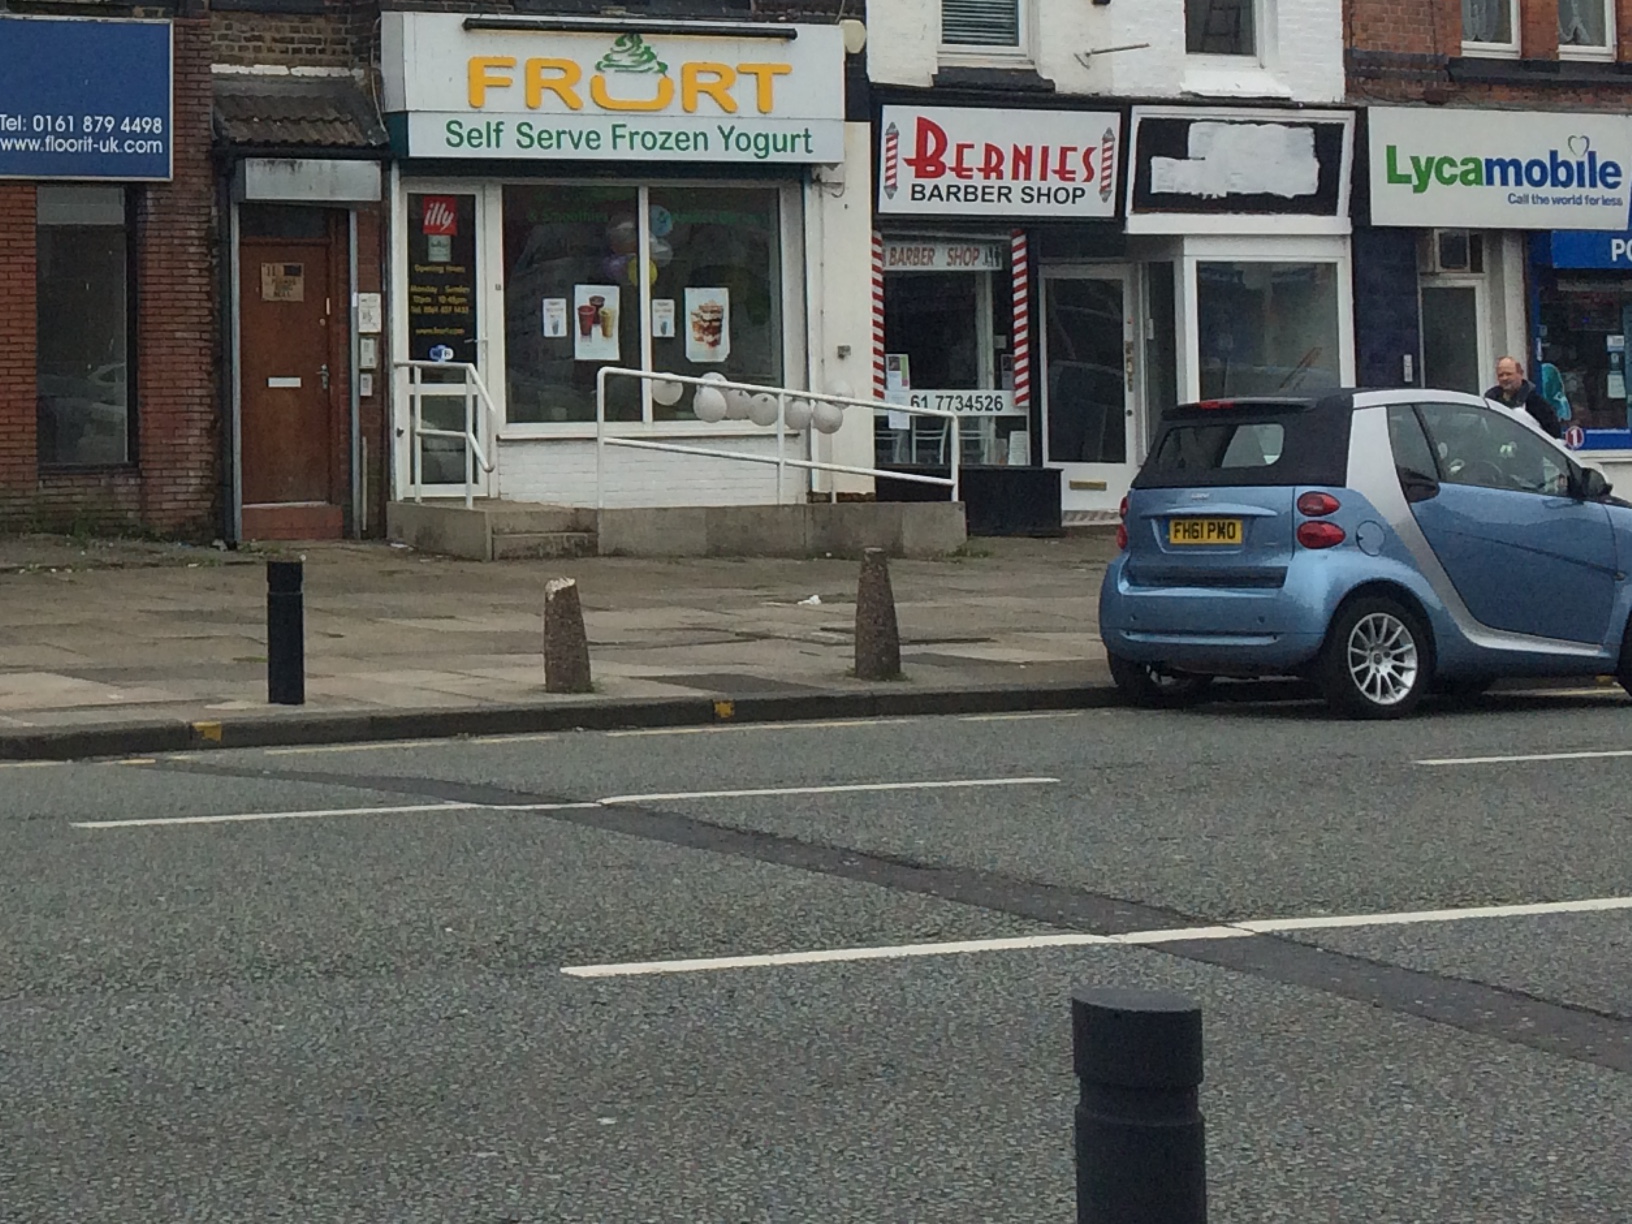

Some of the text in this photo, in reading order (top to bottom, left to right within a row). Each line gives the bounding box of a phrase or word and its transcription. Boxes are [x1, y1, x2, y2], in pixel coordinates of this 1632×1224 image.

[0, 113, 163, 135] Tel: 0161 879 4498
[0, 134, 163, 154] www.floorit-uk.com
[445, 119, 814, 159] Self Serve Frozen Yogurt
[903, 116, 1098, 184] BERNIES
[1386, 140, 1623, 193] Lycamobile
[910, 183, 1086, 206] BARBER SHOP
[1507, 192, 1624, 208] Call the world for less
[424, 202, 455, 232] illy
[889, 247, 981, 266] BARBER SHOP
[935, 395, 1004, 412] 7734526
[1174, 522, 1204, 540] FH61
